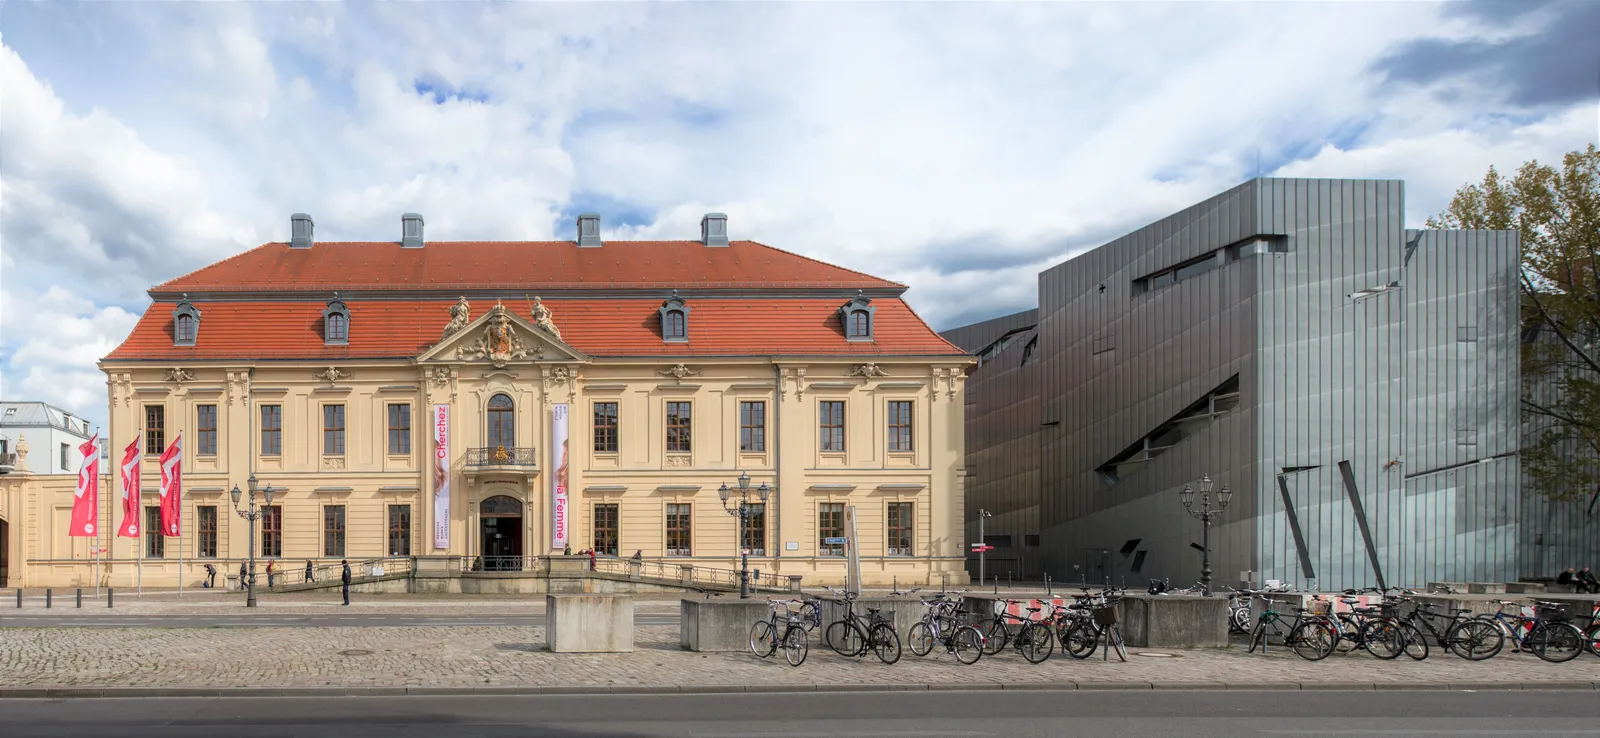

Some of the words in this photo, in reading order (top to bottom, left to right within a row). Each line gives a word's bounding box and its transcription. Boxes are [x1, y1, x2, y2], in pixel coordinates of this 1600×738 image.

[436, 406, 446, 459] Cherchez
[556, 485, 565, 495] la
[556, 498, 566, 540] Femme
